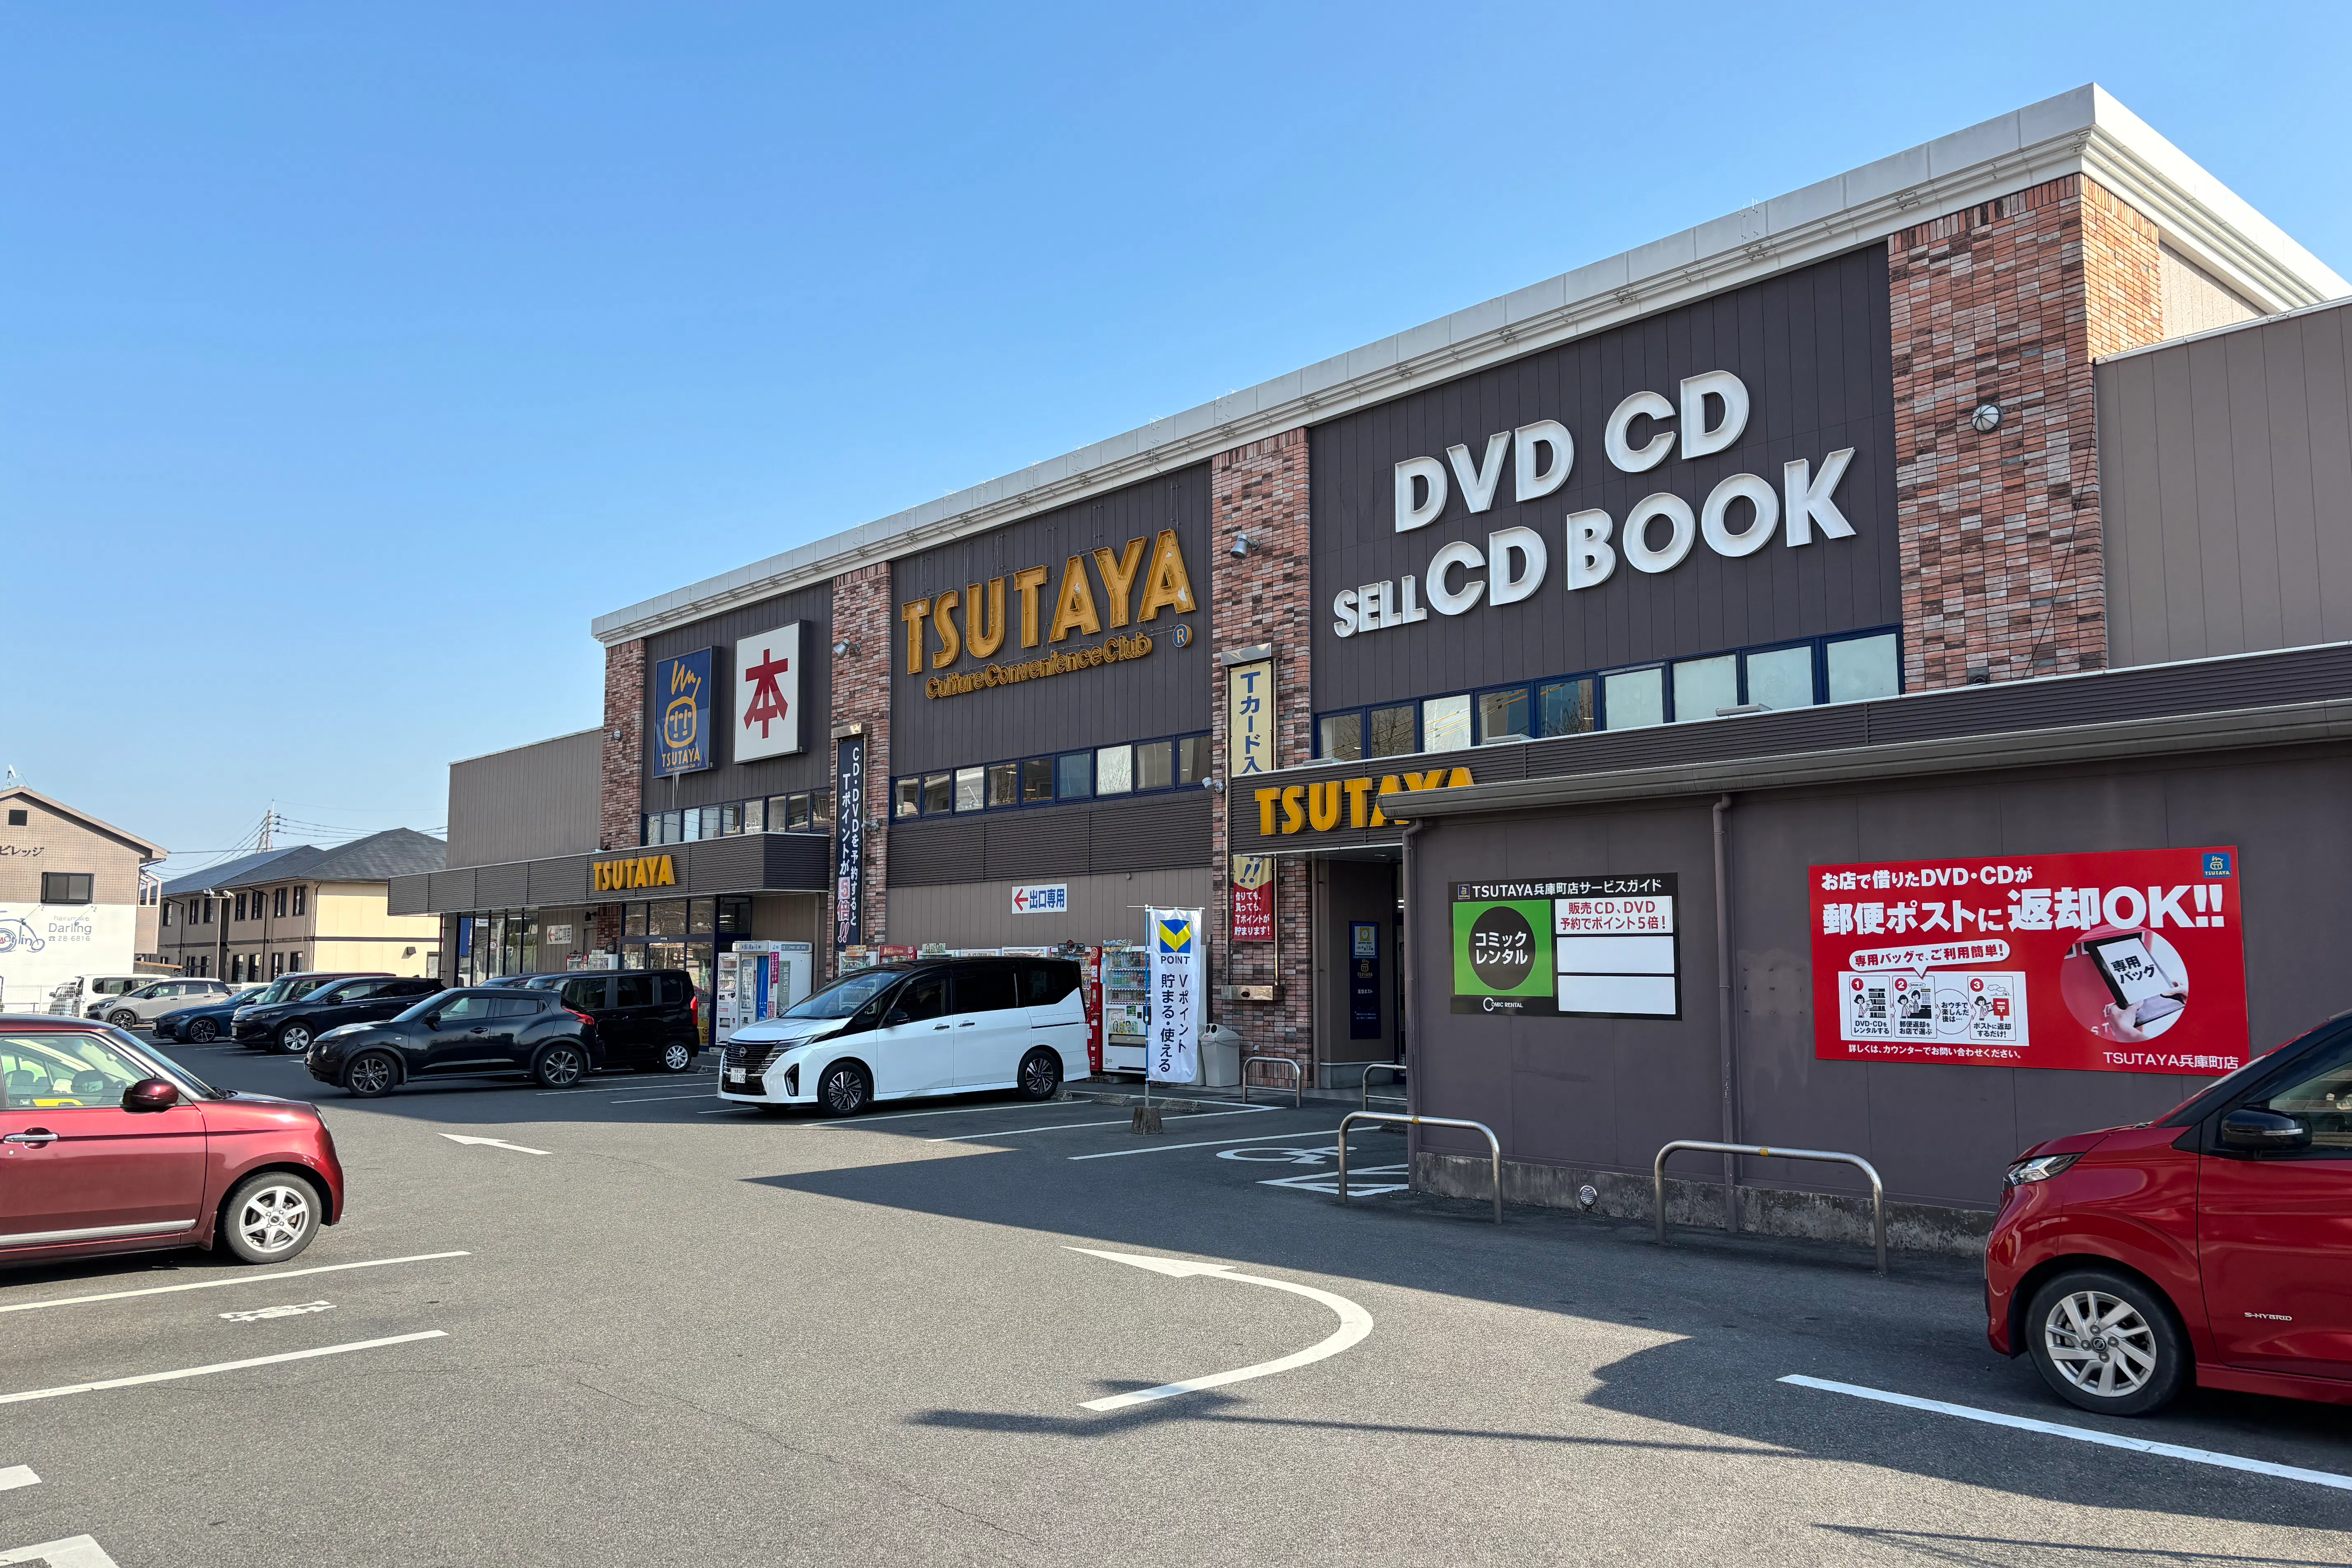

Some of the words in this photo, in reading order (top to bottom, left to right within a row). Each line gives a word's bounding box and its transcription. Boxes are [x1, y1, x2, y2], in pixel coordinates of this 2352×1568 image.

[1395, 420, 1574, 532] DVD
[1605, 370, 1749, 472] CD
[1333, 575, 1427, 637] SELL
[1426, 526, 1547, 616] CD
[1567, 447, 1856, 591] BOOK
[902, 529, 1196, 674] TSUTAYA
[744, 649, 788, 739] 本
[662, 747, 700, 768] TSUTAYA
[850, 747, 860, 926] CD・DVDを予約すると
[837, 773, 851, 943] Tポイントが5倍!!
[593, 855, 675, 891] TSUTAYA
[1821, 866, 2032, 890] お店で借りたDVD・CDが
[1029, 888, 1065, 909] 出口専用
[1472, 879, 1662, 898] TSUTAYA兵庫町店サービスガイド
[49, 923, 91, 935] Darling
[1235, 914, 1269, 924] Tポイントが
[1561, 916, 1666, 931] 予約でポイント5倍!
[1234, 926, 1270, 936] 貯まります!
[1475, 931, 1527, 947] コミック
[1160, 956, 1190, 965] POINT
[1476, 950, 1528, 965] レンタル
[1855, 944, 2003, 966] 専用バッグで、ご利用簡単!
[2111, 955, 2141, 972] 専用
[2120, 964, 2155, 984] バッグ
[1974, 981, 1981, 989] 3
[1158, 974, 1175, 1073] 貯まる・使える
[1178, 974, 1189, 1053] Vポイント
[1848, 1044, 2021, 1059] 詳しくは、カウンターでお問い合わせください。
[2103, 1052, 2238, 1069] TSUTAYA兵庫町店
[2245, 1312, 2292, 1321] S-HYBRID
